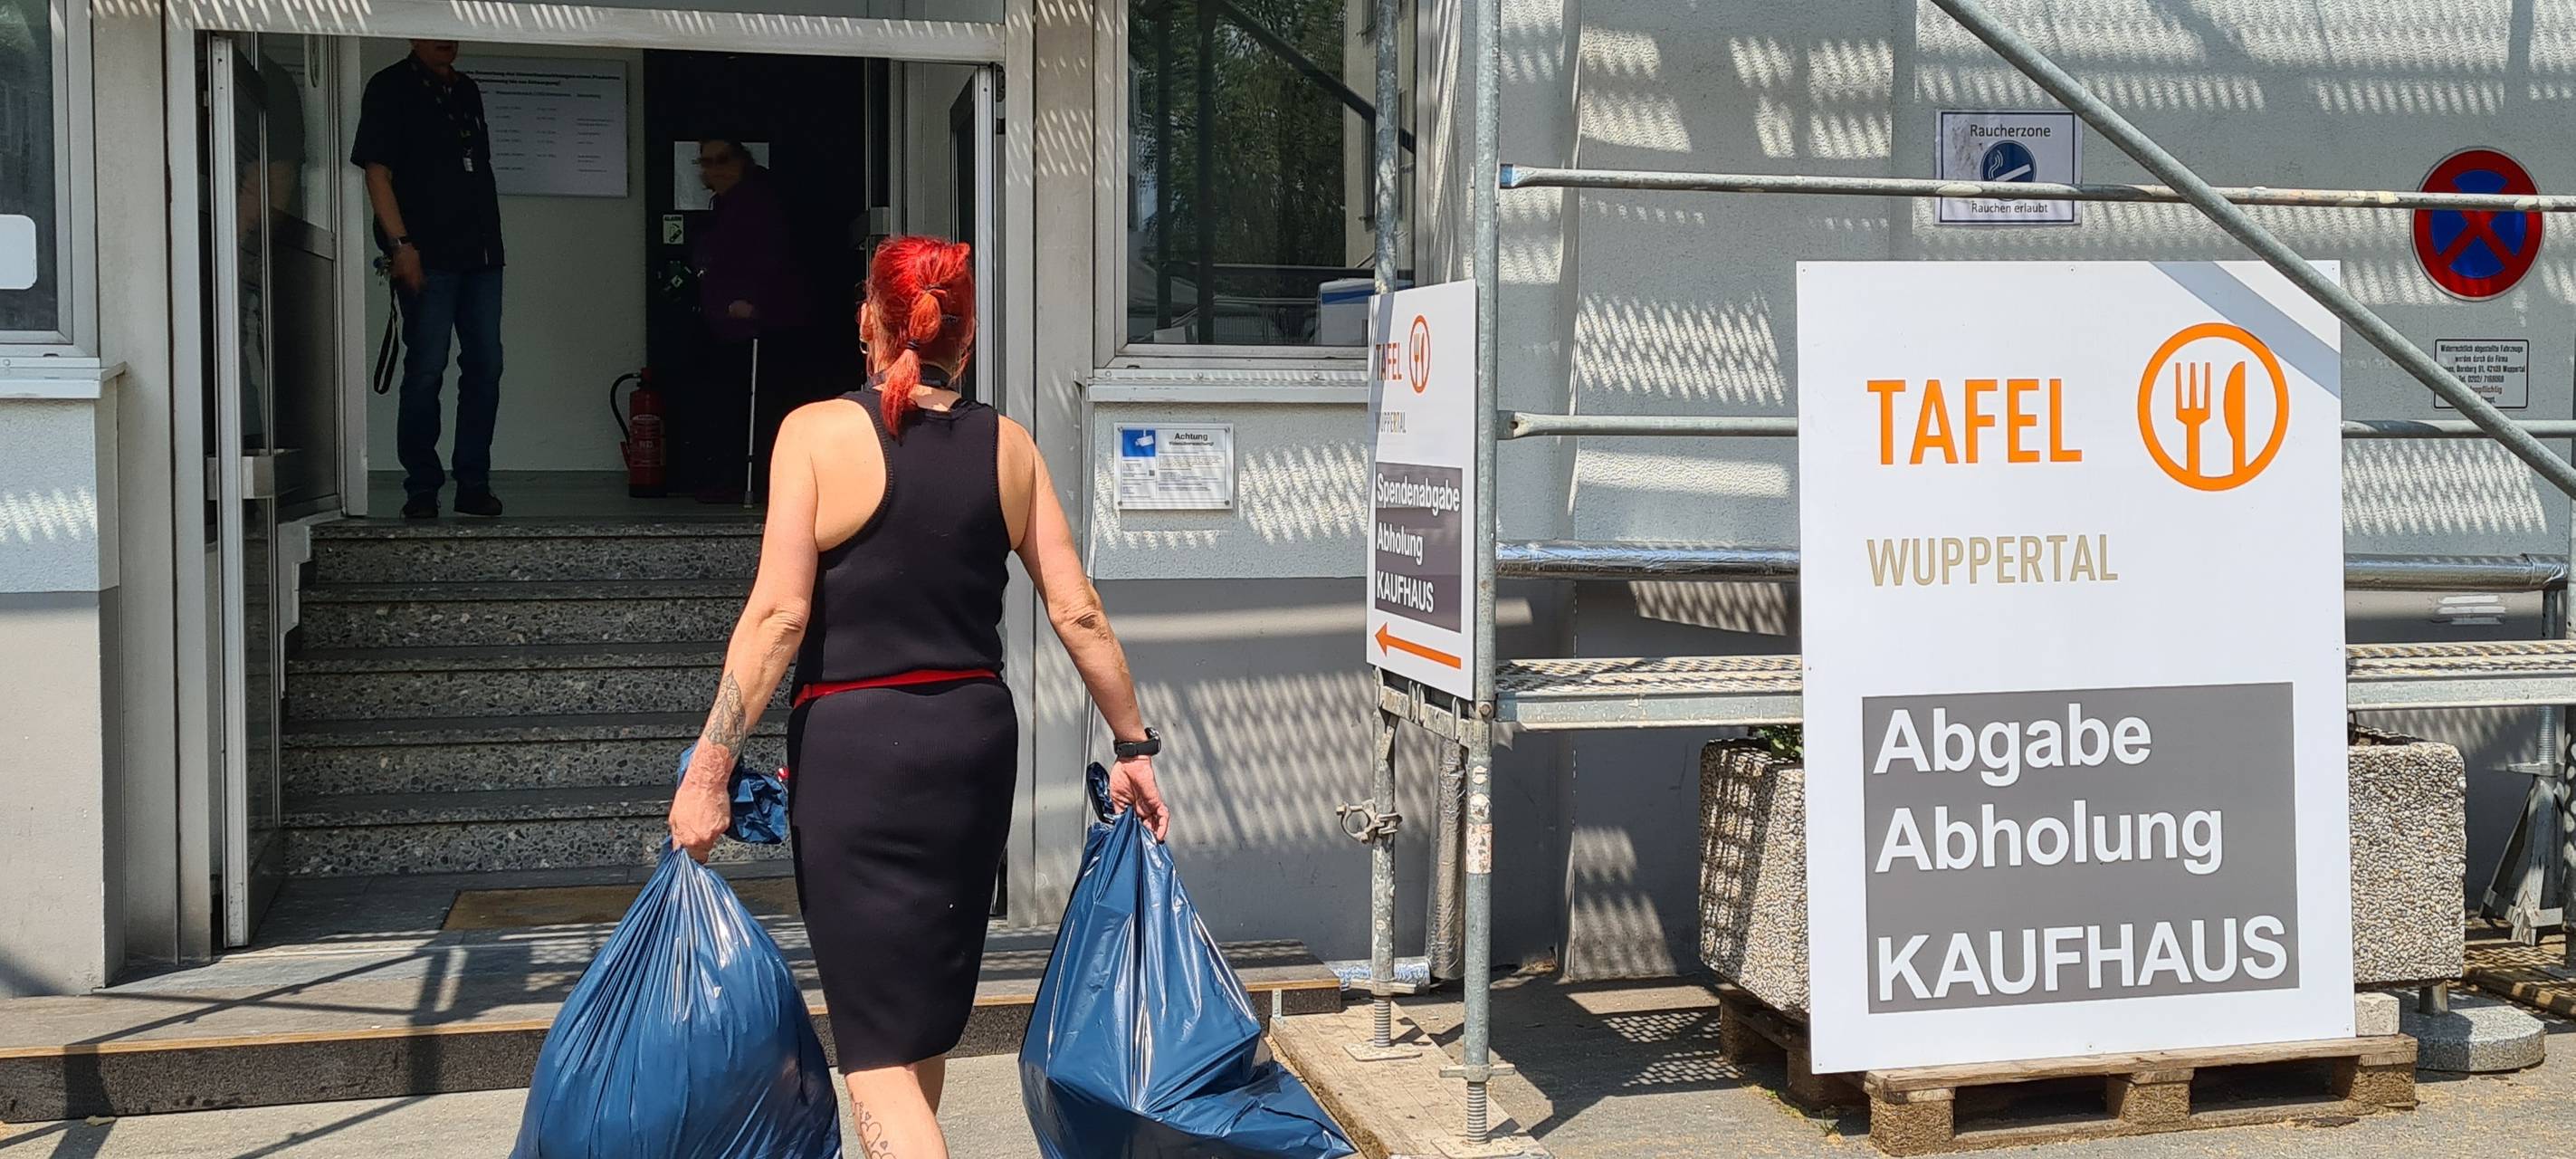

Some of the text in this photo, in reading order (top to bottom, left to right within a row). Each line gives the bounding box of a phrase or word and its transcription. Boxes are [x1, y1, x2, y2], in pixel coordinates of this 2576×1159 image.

[1970, 124, 2051, 138] Raucherzone
[1971, 203, 2048, 214] Rauchen erlaubt
[1375, 342, 1403, 381] TAFEL
[1174, 433, 1208, 442] Achtung
[1866, 378, 2083, 465] TAFEL
[1377, 473, 1460, 516] Spendenabgabe
[1377, 522, 1424, 566] Abholung
[1866, 533, 2119, 588] WUPPERTAL
[1377, 570, 1434, 613] KAUFHAUS
[1872, 703, 2152, 787] Abgabe
[1874, 799, 2223, 875] Abholung
[1877, 915, 2288, 1001] KAUFHAUS
